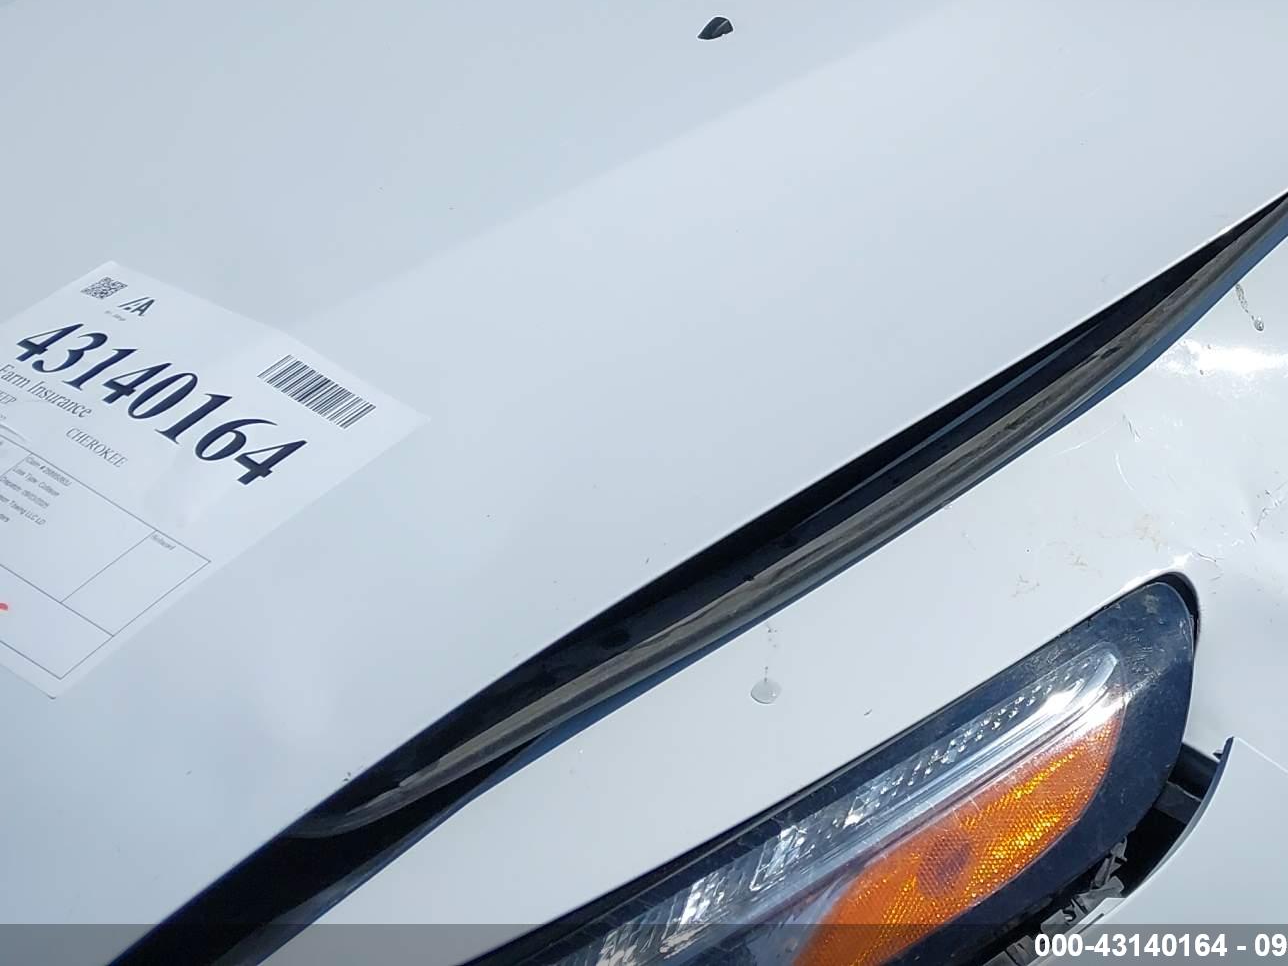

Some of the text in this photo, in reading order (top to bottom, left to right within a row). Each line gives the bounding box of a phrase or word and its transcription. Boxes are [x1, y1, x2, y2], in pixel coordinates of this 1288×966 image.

[0, 364, 92, 418] Farm Insurance
[15, 323, 307, 485] 43140164
[66, 427, 128, 468] CHEROKEE
